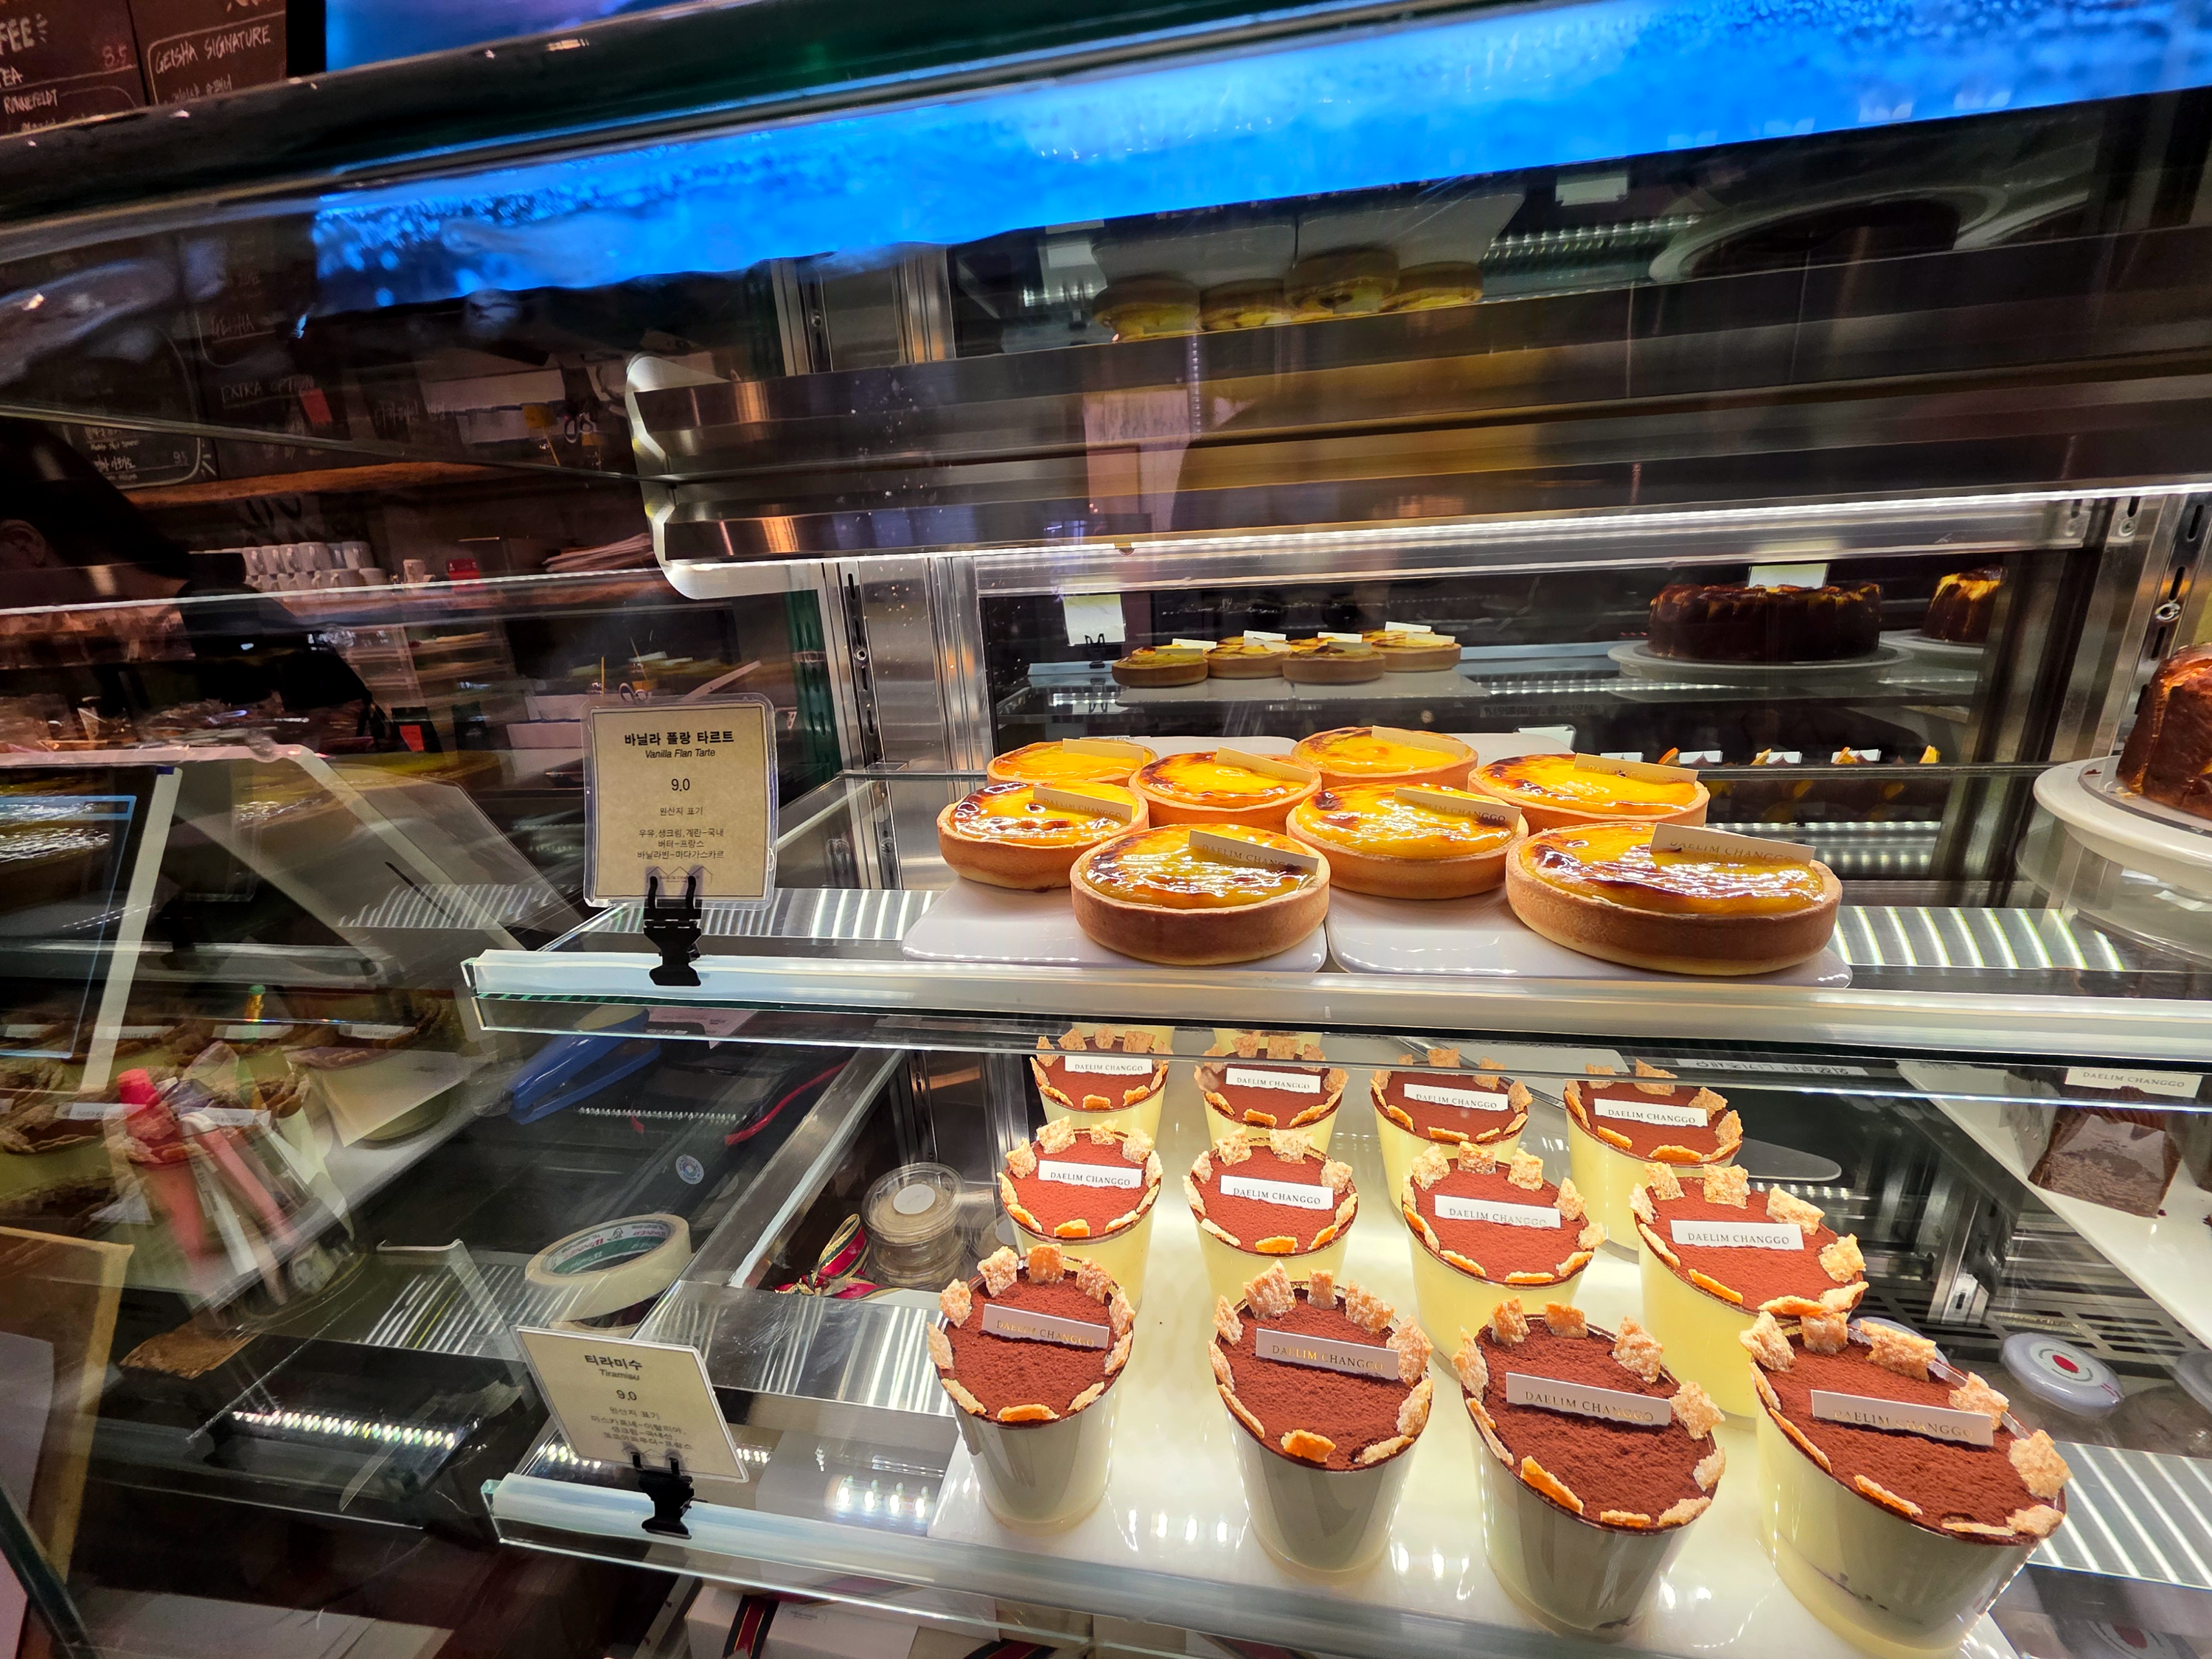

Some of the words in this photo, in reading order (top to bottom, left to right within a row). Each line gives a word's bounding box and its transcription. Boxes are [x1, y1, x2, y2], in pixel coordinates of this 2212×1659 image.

[156, 41, 198, 74] GEISHA
[204, 25, 271, 60] SIGNATURE
[625, 733, 661, 746] 바닐라
[667, 731, 691, 745] 플랑
[697, 731, 734, 744] 타르트
[645, 750, 672, 759] Vanilla
[674, 749, 692, 758] Flan
[695, 748, 715, 758] Tarte
[671, 778, 691, 791] 9.0
[659, 807, 684, 816] 원산지
[686, 807, 703, 815] 표기
[1043, 798, 1076, 810] DAELIM
[1078, 805, 1122, 818] CHANGGO
[1202, 844, 1242, 859] DAELIM
[1074, 1063, 1102, 1071] DAELIM
[1237, 1077, 1267, 1086] DAELIM
[1269, 1080, 1310, 1090] CHANGGO
[2083, 1071, 2124, 1081] DAELIM
[2127, 1077, 2185, 1088] CHANGGO
[1451, 1097, 1498, 1109] CHANGGO
[1607, 1108, 1644, 1121] DAELIM
[1646, 1112, 1696, 1124] CHANGGO
[1050, 1171, 1083, 1183] DAELIM
[1085, 1174, 1130, 1186] CHANGGO
[1234, 1187, 1269, 1200] DAELIM
[1272, 1191, 1321, 1205] CHANGGO
[1449, 1207, 1489, 1222] DAELIM
[1491, 1212, 1548, 1227] CHANGGO
[1688, 1231, 1731, 1244] DAELIM
[1733, 1233, 1790, 1245] CHANGGO
[996, 1319, 1037, 1337] DAELIM
[1040, 1327, 1096, 1347] CHANGGO
[584, 1354, 643, 1371] 티라미수
[1272, 1344, 1318, 1362] DAELIM
[1321, 1351, 1385, 1373] CHANGGO
[599, 1368, 640, 1381] Tiramisu
[616, 1389, 637, 1401] 9.0
[609, 1406, 638, 1417] 원산지
[641, 1411, 661, 1421] 표기
[1524, 1390, 1578, 1411] DAELIM
[1582, 1398, 1654, 1422] CHANGGO
[1834, 1408, 1891, 1428] DAELIM
[1894, 1418, 1975, 1439] CHANGGO
